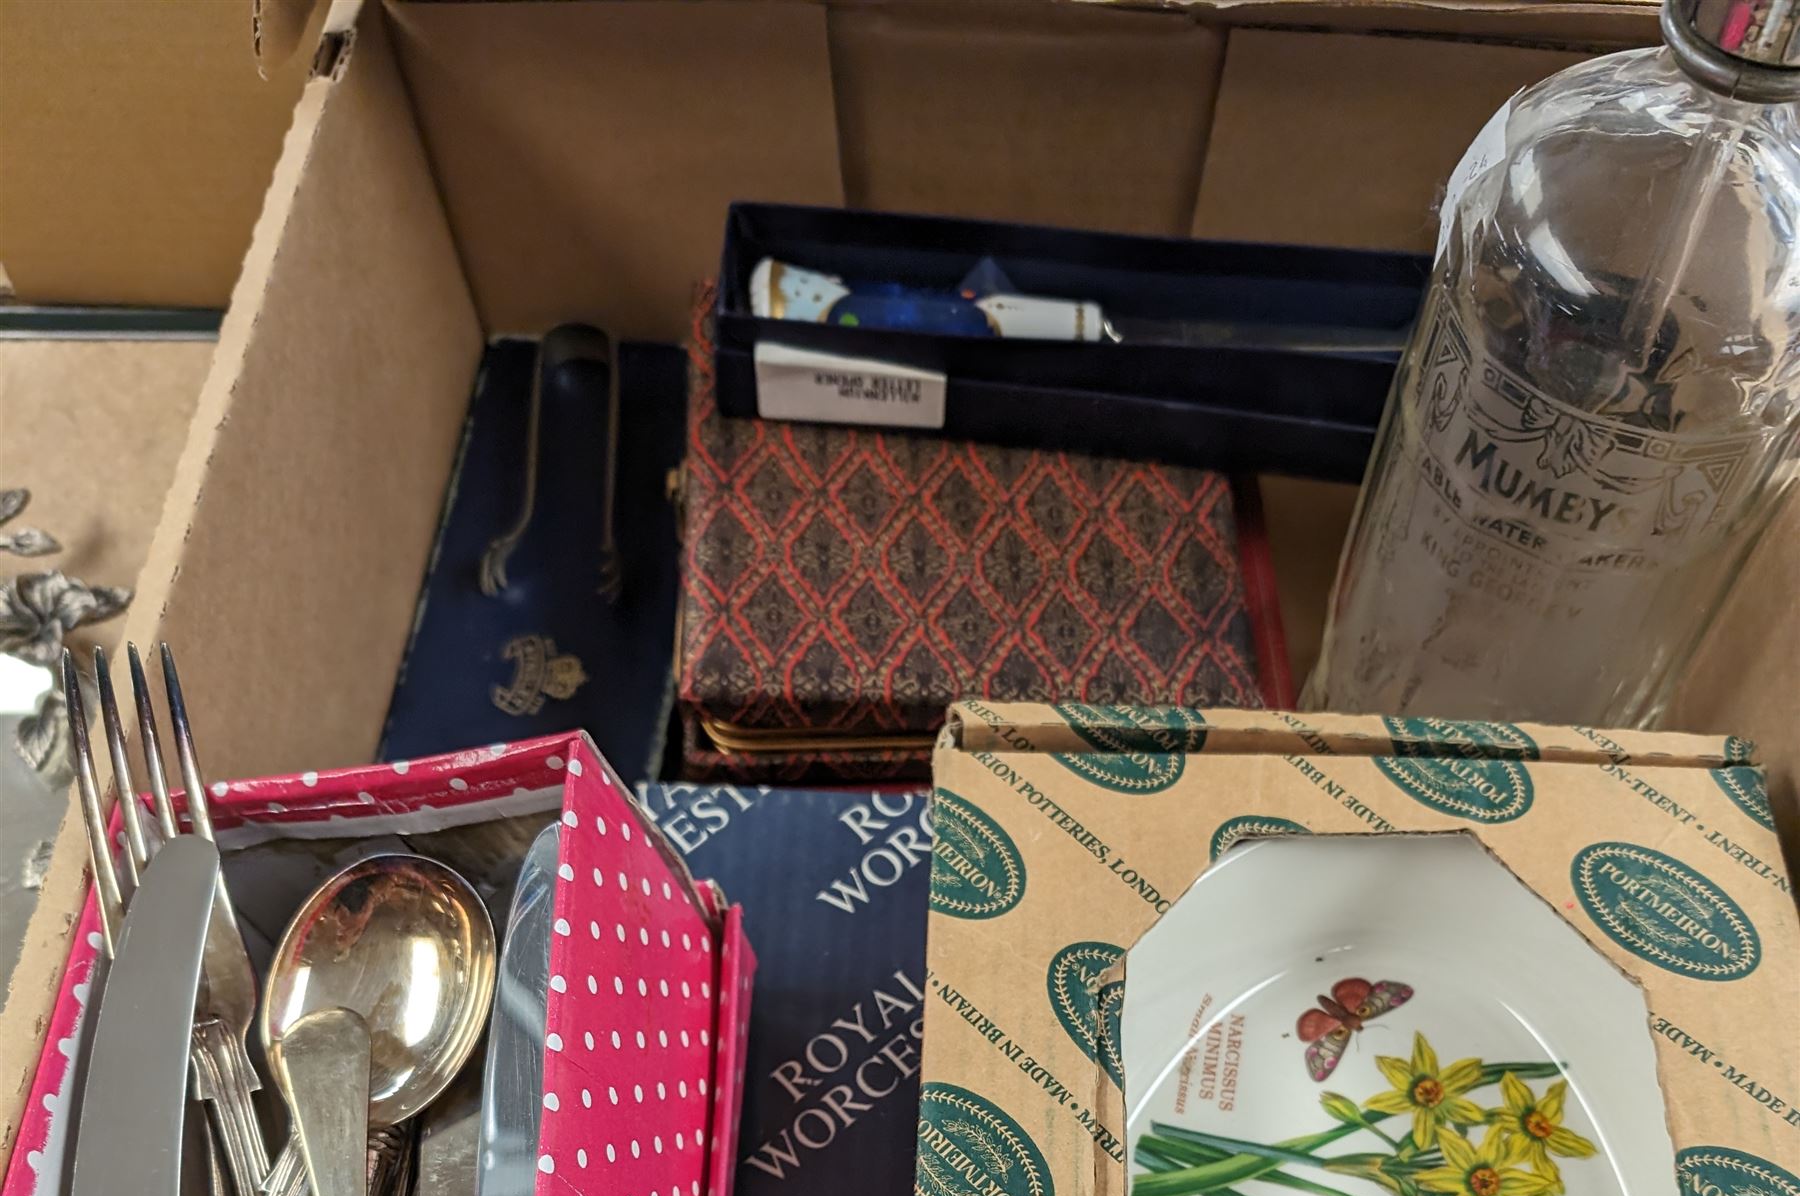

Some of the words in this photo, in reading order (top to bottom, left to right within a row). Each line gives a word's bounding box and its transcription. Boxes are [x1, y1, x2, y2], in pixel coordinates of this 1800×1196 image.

[1420, 456, 1462, 509] ABLE
[1321, 777, 1347, 800] IN
[1016, 781, 1110, 866] POTTERIES,
[1599, 861, 1734, 961] PORTMEIRION
[936, 983, 1004, 1046] BRITAIN
[1652, 1016, 1716, 1064] MADE
[998, 1038, 1026, 1064] IN
[1199, 1021, 1224, 1101] MINIMUS
[1217, 1012, 1246, 1113] NARCISSUS
[1018, 1056, 1075, 1107] MADE
[1720, 1064, 1788, 1115] MADE
